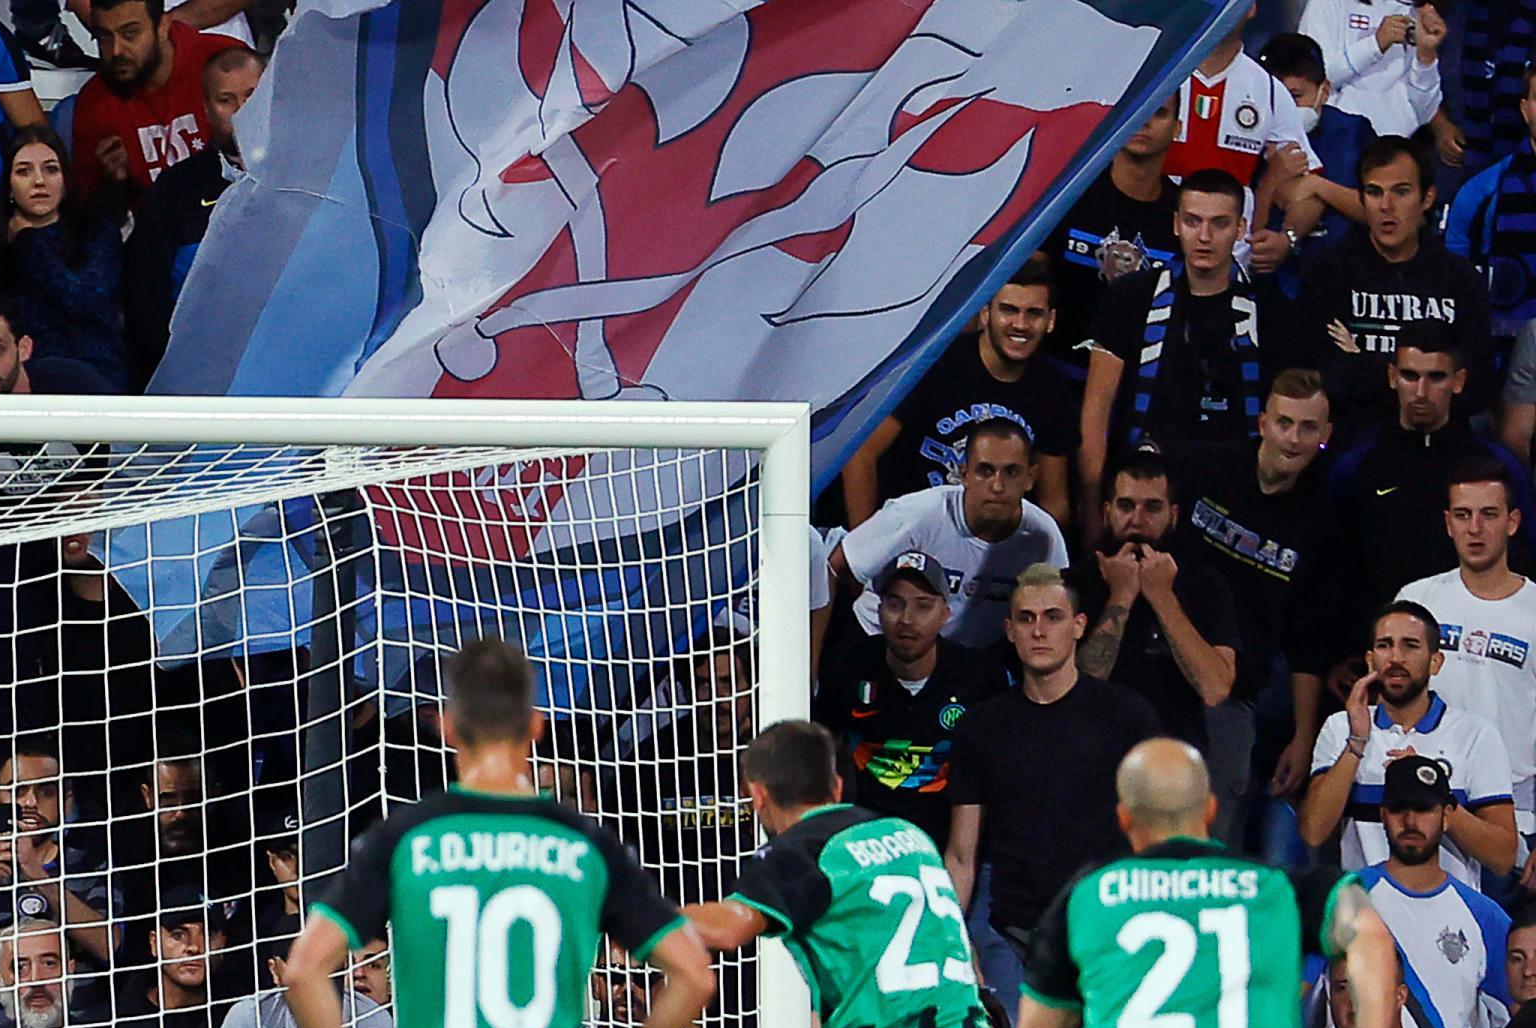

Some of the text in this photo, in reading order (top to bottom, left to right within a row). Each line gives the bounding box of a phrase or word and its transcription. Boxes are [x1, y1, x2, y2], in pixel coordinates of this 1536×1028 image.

[1351, 289, 1456, 324] ULTRAS
[1488, 638, 1526, 663] RAS
[1098, 867, 1259, 907] CHIRICHES
[868, 864, 978, 994] 25
